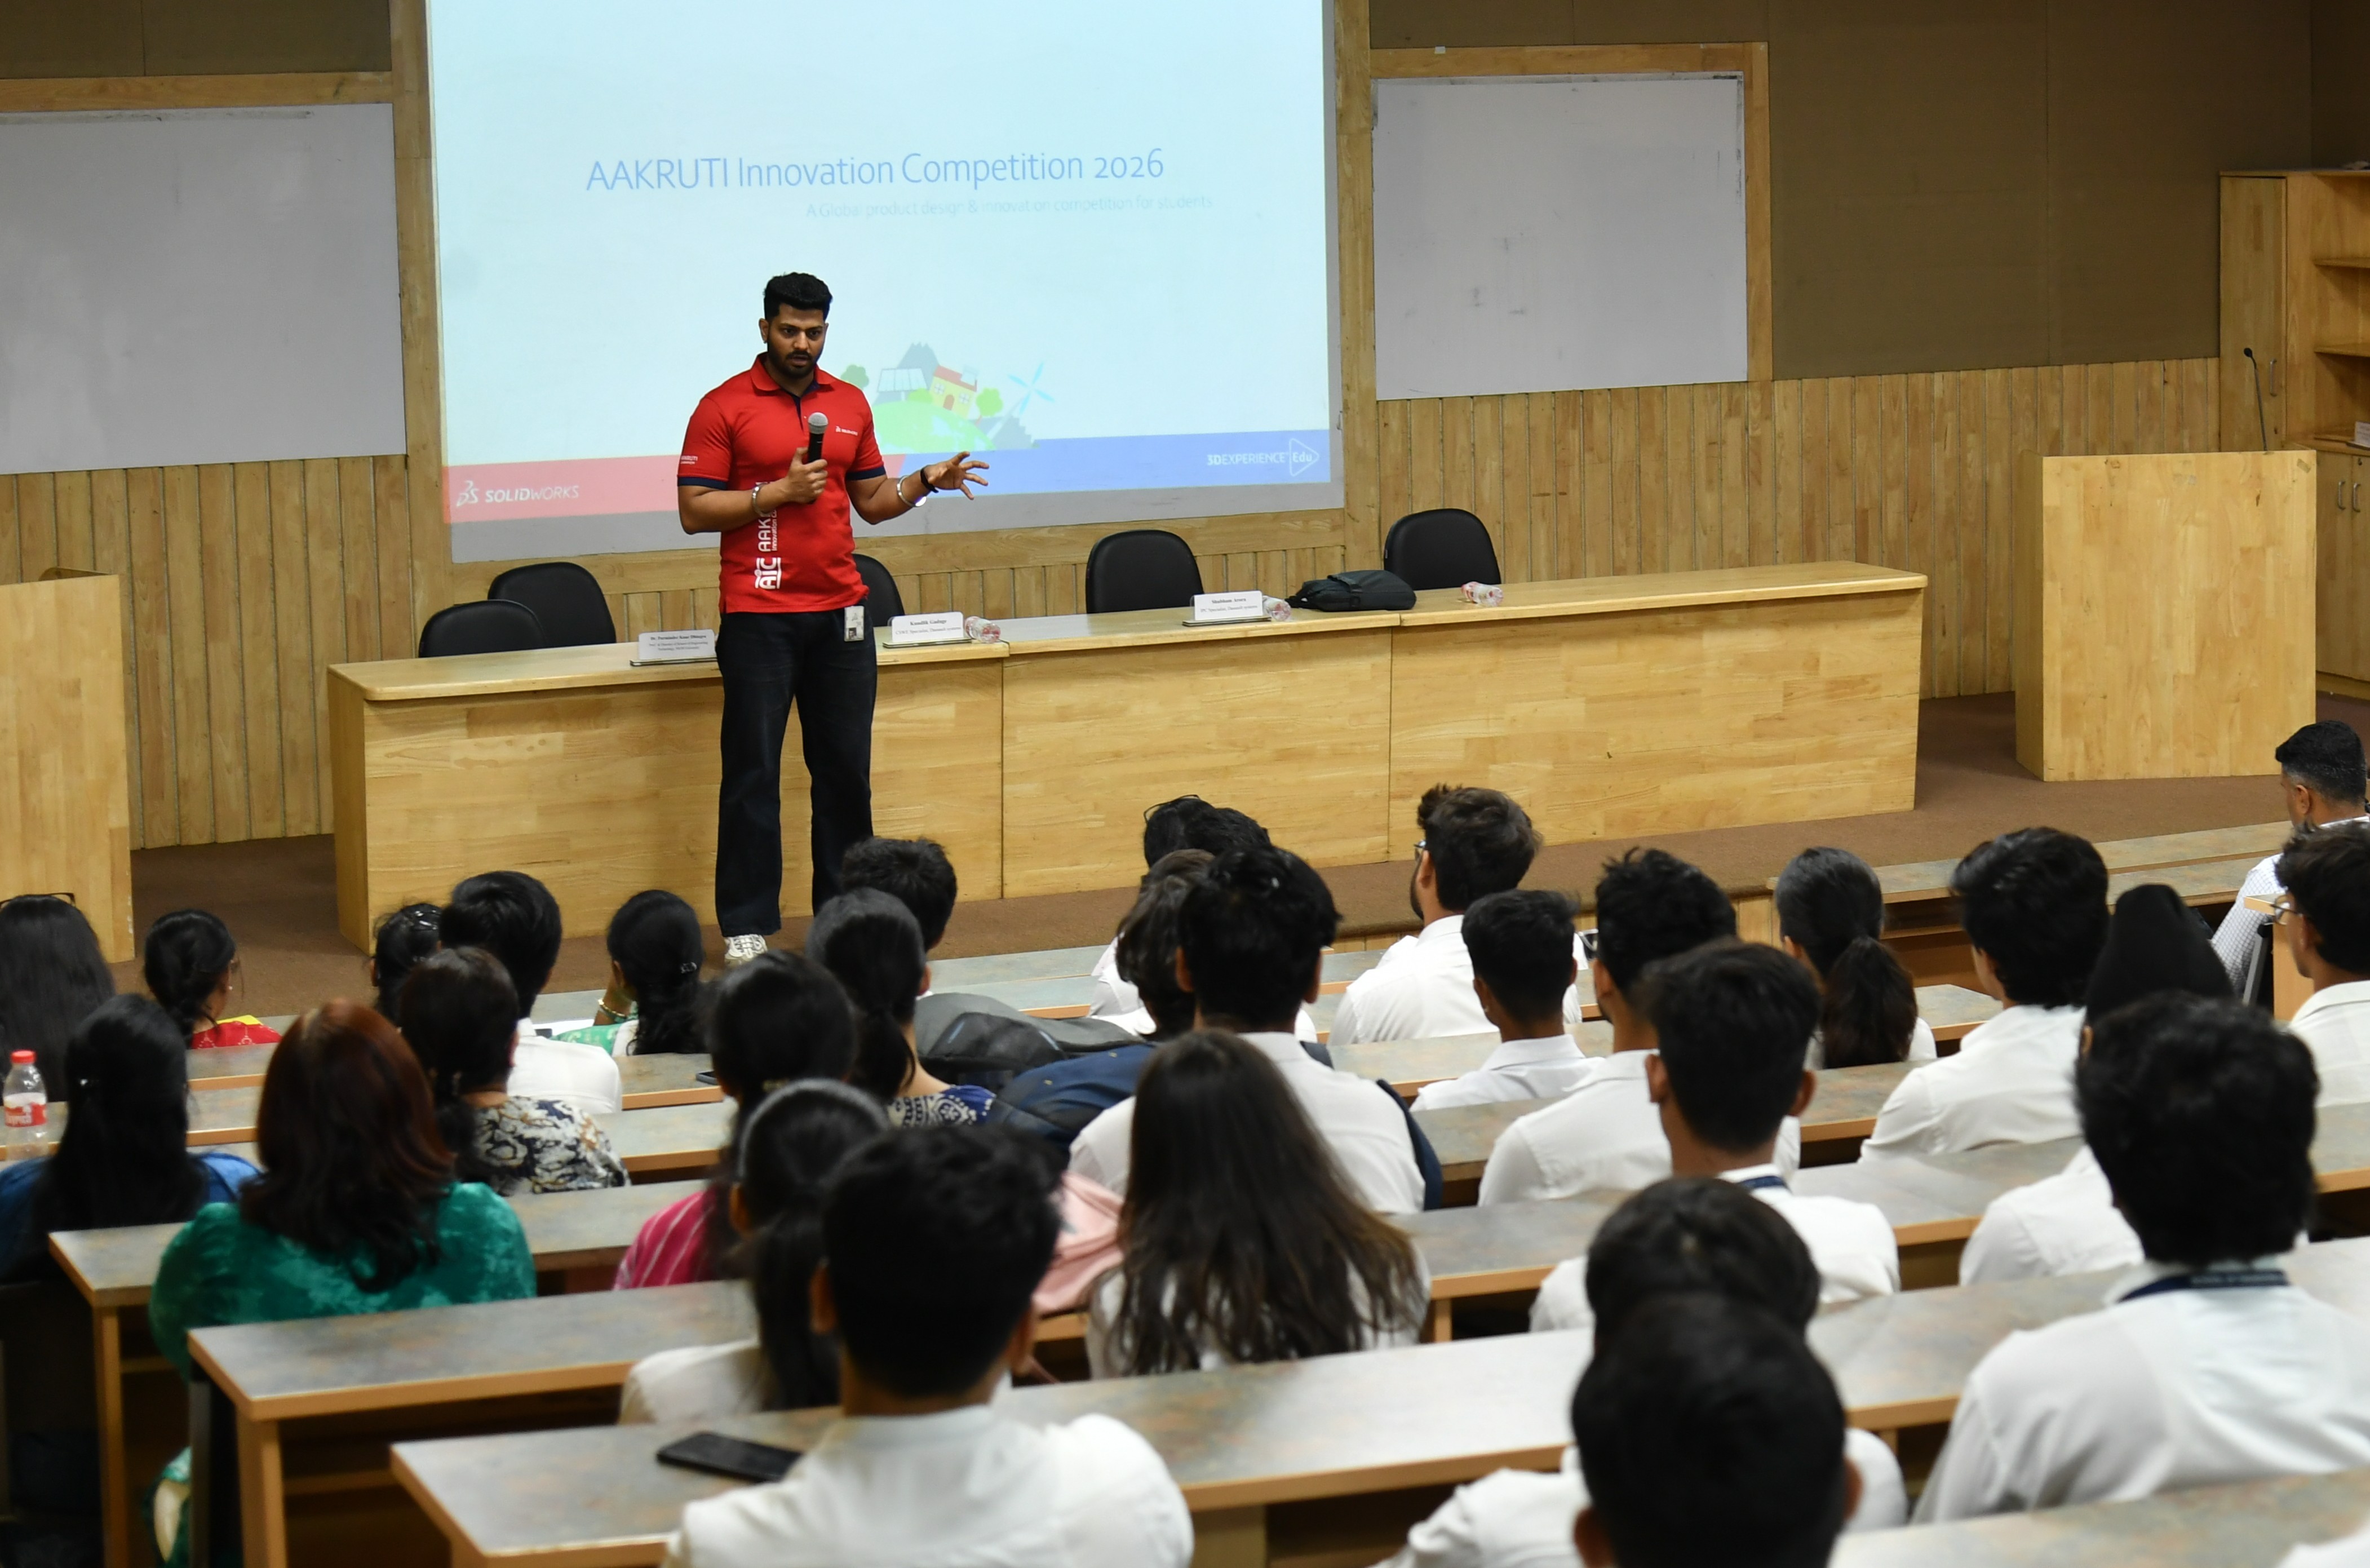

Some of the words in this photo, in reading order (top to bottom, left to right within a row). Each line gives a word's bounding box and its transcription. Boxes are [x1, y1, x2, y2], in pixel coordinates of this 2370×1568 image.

[586, 157, 729, 191] AAKRUTI
[738, 157, 893, 187] Innovation
[901, 152, 1083, 191] Competition
[1094, 148, 1164, 179] 2026
[805, 203, 817, 218] A
[866, 201, 918, 219] product
[967, 199, 978, 214] &
[1053, 196, 1133, 214] competition
[1135, 194, 1154, 210] for
[1207, 451, 1285, 466] 3DEXPERIENCE
[1292, 451, 1313, 463] Edu
[485, 485, 579, 503] SOLIDWORKS
